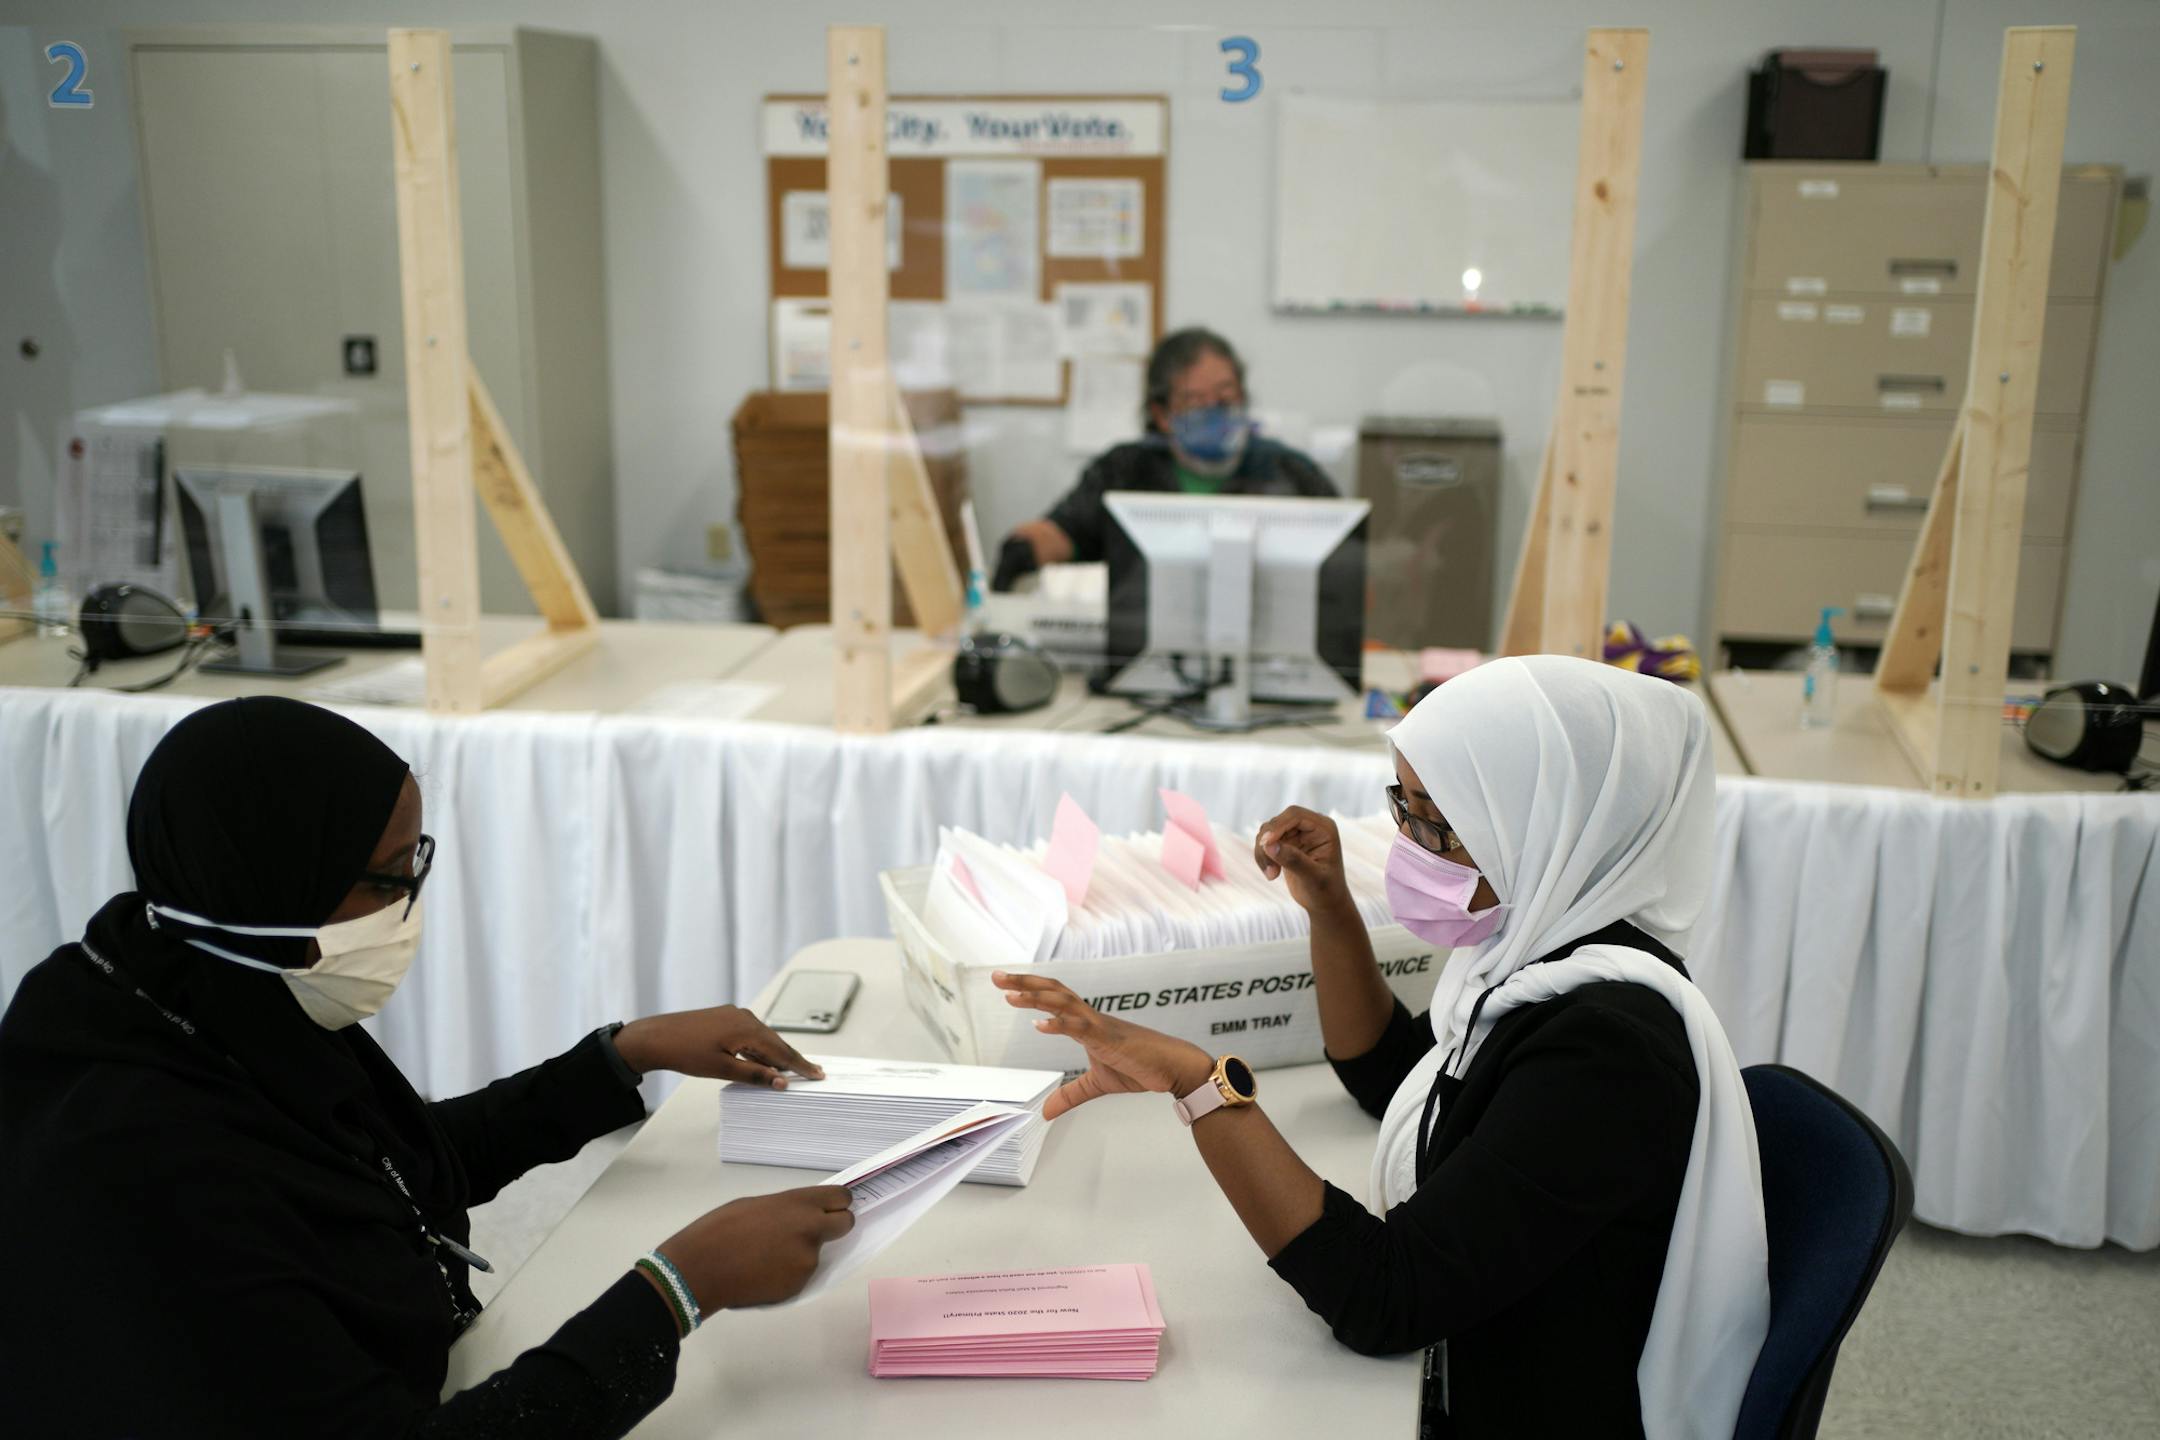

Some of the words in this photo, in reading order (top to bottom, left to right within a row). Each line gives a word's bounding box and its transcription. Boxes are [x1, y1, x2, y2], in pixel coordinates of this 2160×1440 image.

[45, 41, 93, 108] 2
[1220, 36, 1263, 103] 3
[796, 111, 828, 140] Yo
[1083, 991, 1151, 1012] NITED
[1156, 981, 1243, 1007] STATES
[1247, 972, 1316, 996] POSTA
[1377, 954, 1433, 977] VICE
[1210, 1019, 1248, 1036] EMM
[1251, 1013, 1292, 1030] TRAY
